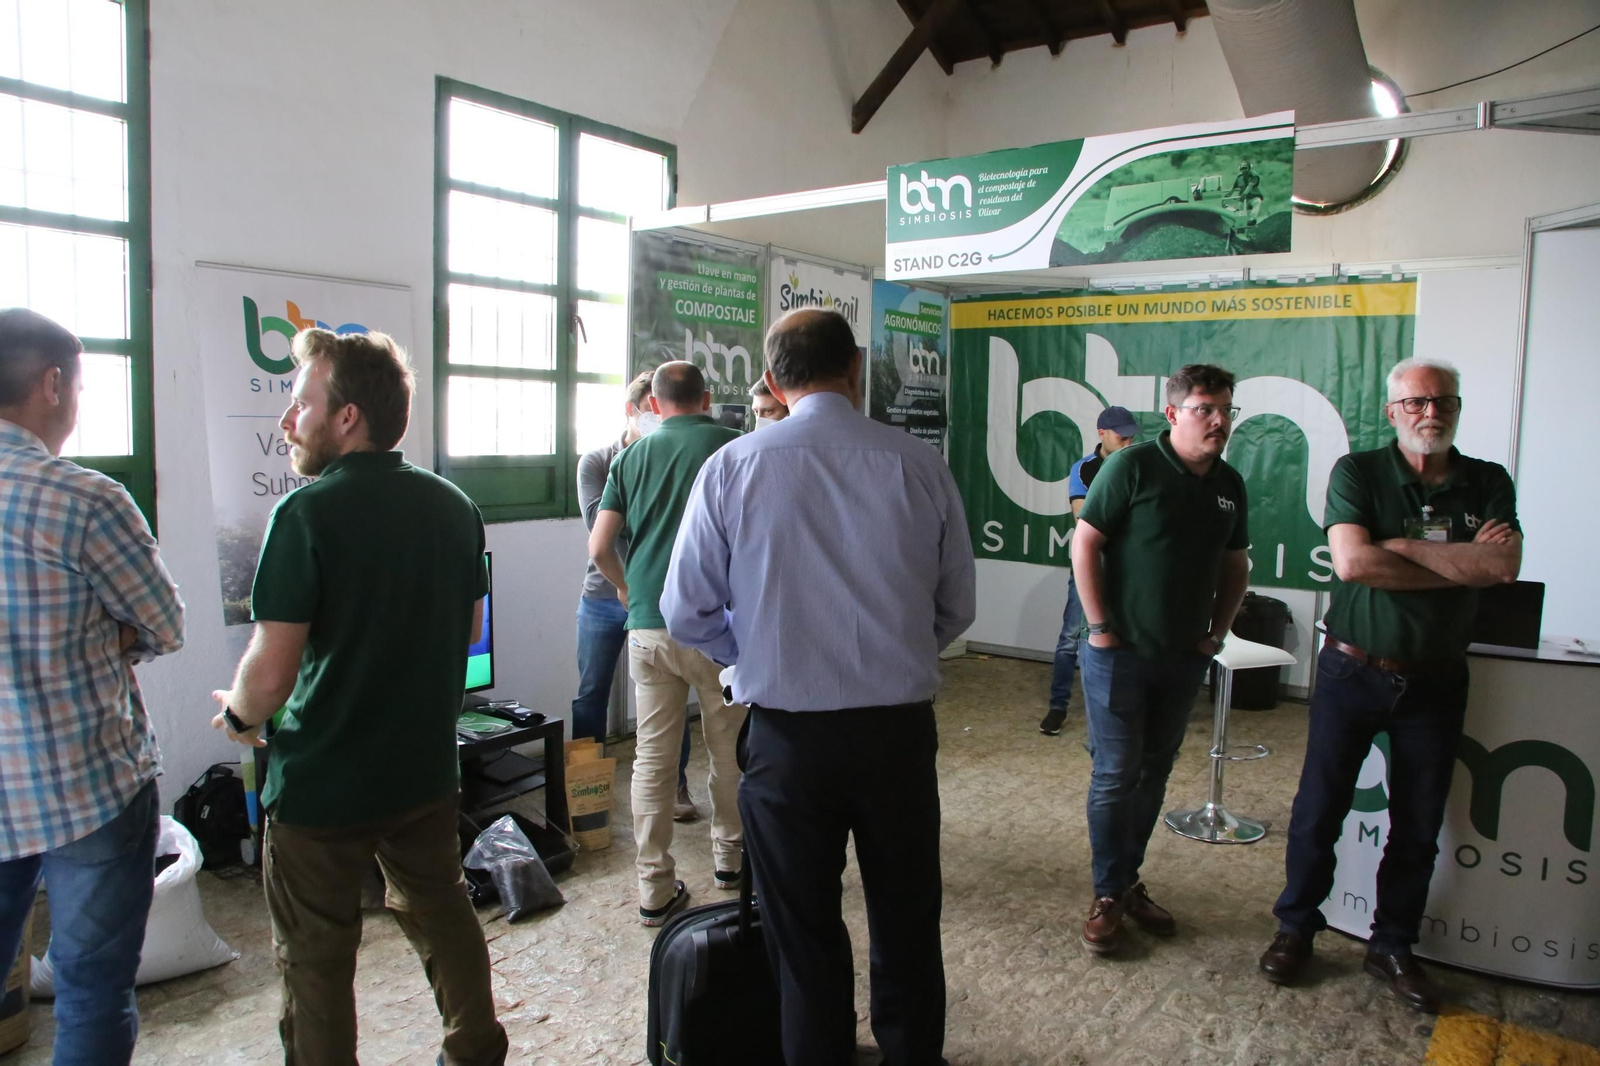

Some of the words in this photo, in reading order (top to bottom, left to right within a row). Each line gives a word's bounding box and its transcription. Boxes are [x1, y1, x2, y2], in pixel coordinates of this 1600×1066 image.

[977, 166, 1028, 182] Biotecnología
[1029, 167, 1049, 180] para
[900, 170, 972, 215] btm
[977, 185, 985, 194] el
[985, 181, 1026, 196] compostaje
[1026, 179, 1037, 189] de
[979, 194, 1010, 206] residuos
[1010, 192, 1023, 203] del
[900, 209, 972, 226] SIMBIOSIS
[977, 207, 1002, 217] Olivar
[894, 254, 943, 273] STAND
[948, 251, 982, 268] C2G
[697, 263, 720, 278] Llave
[721, 269, 732, 279] en
[733, 273, 757, 284] mano
[659, 277, 666, 289] y
[667, 279, 700, 293] gestión
[702, 283, 713, 295] de
[714, 285, 745, 300] plantas
[746, 289, 757, 301] de
[675, 299, 756, 324] COMPOSTAJE
[920, 305, 943, 318] Servicios
[987, 306, 1054, 321] HACEMOS
[1057, 304, 1112, 319] POSIBLE
[1116, 303, 1139, 316] UN
[1144, 300, 1207, 315] MUNDO
[1211, 296, 1247, 313] MÁS
[1251, 294, 1353, 312] SOSTENIBLE
[884, 313, 942, 336] AGRONÓMICOS
[709, 384, 752, 397] BIOSIS
